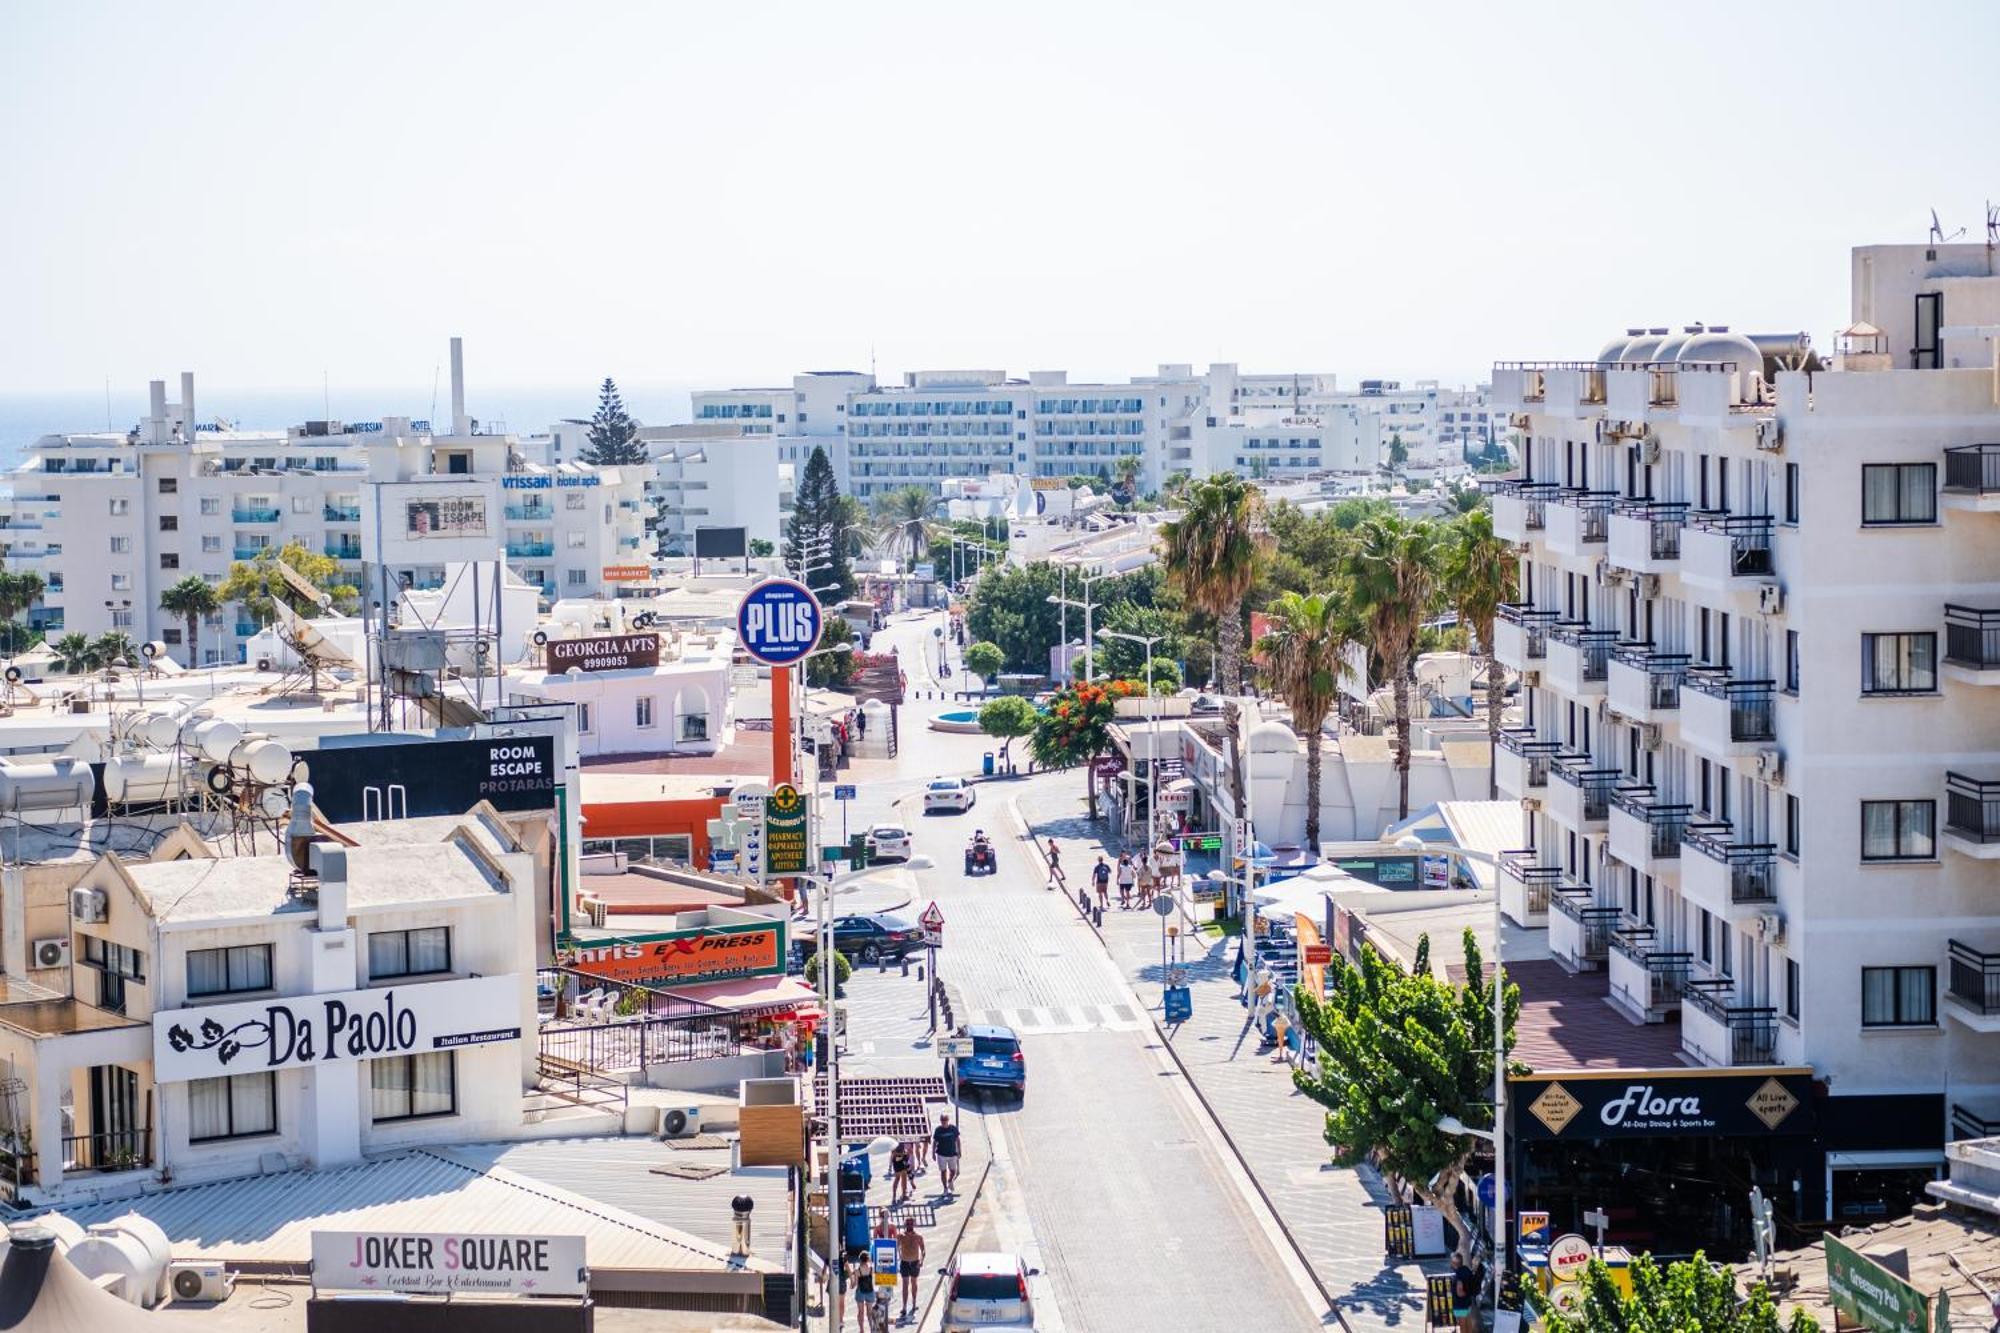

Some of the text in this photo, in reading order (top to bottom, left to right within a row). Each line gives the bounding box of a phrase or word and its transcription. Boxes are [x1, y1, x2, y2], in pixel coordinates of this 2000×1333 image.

[502, 474, 552, 488] vrissaki
[444, 512, 484, 523] ESCAPE
[746, 602, 813, 643] PLUS
[555, 637, 655, 658] GEORGIA APTS
[584, 656, 627, 669] 99909053
[490, 746, 535, 760] ROOM
[490, 762, 542, 776] ESCAPE
[480, 778, 553, 793] PROTARAS
[768, 832, 803, 841] PHARMACY
[654, 934, 766, 962] EXPRESS
[698, 967, 755, 981] STORE
[266, 991, 416, 1066] Da Paolo
[441, 1032, 514, 1046] Italian Restaurant
[1756, 1094, 1788, 1102] All Live
[1601, 1086, 1700, 1126] Flora
[1622, 1120, 1647, 1129] All-Day
[1649, 1120, 1672, 1128] Dining
[1680, 1120, 1702, 1128] Sports
[1703, 1119, 1716, 1127] Bar
[1525, 1217, 1546, 1225] ATM
[350, 1237, 549, 1271] JOKER SQUARE
[1558, 1253, 1587, 1265] KEO
[387, 1274, 421, 1287] Cocktail
[426, 1274, 442, 1289] Bar
[1850, 1267, 1883, 1305] Greenery
[1884, 1288, 1899, 1312] Pub
